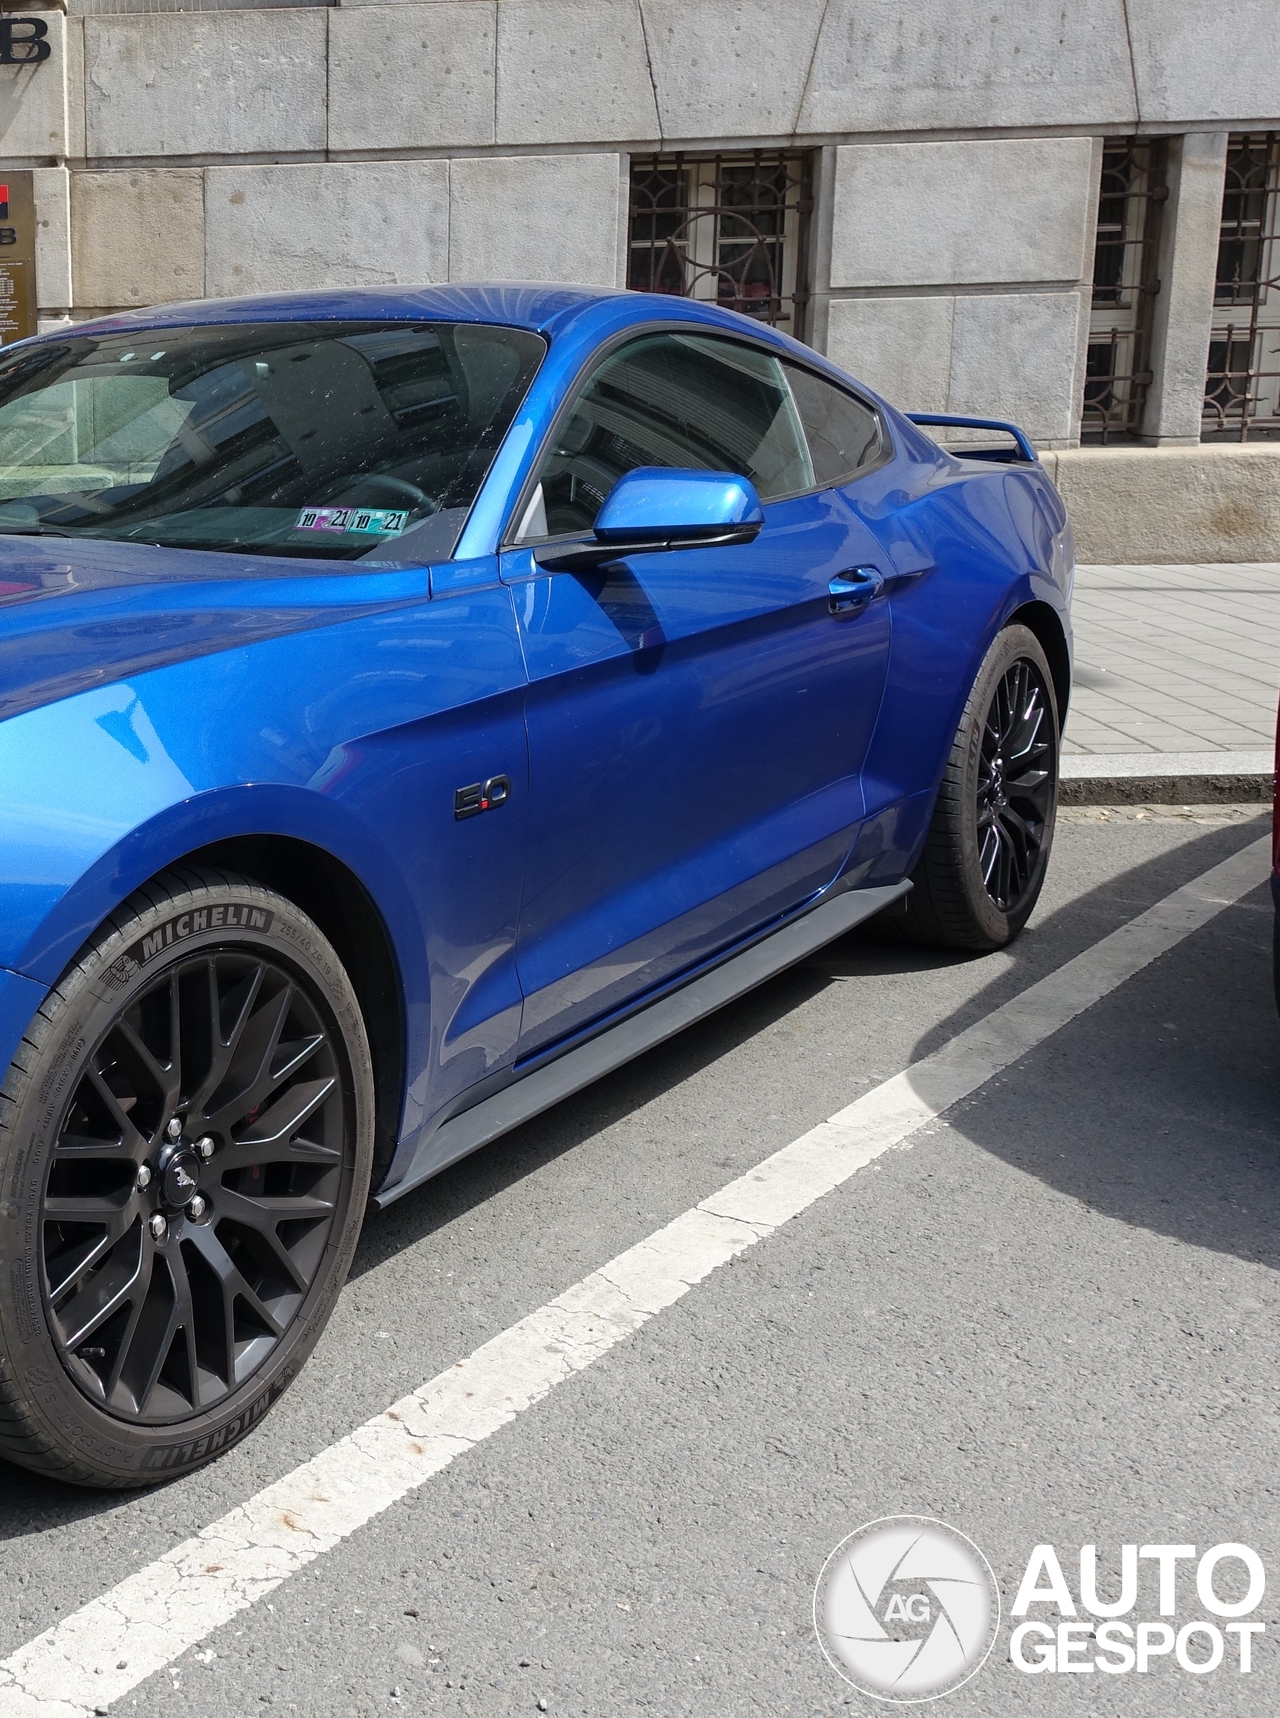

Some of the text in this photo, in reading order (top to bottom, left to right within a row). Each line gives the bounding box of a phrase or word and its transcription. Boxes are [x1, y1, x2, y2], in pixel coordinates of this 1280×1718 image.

[330, 510, 349, 527] 21
[384, 513, 402, 530] 21
[455, 774, 511, 820] 5.0
[142, 906, 267, 961] MICHELIN
[280, 922, 332, 975] 255/40 ZR 19
[10, 1149, 24, 1198] MICHELIN
[25, 1209, 34, 1243] EXTRA
[45, 1394, 56, 1404] S
[57, 1414, 98, 1447] SPORT
[146, 1391, 270, 1468] MICHELIN
[96, 1443, 135, 1463] PILOT
